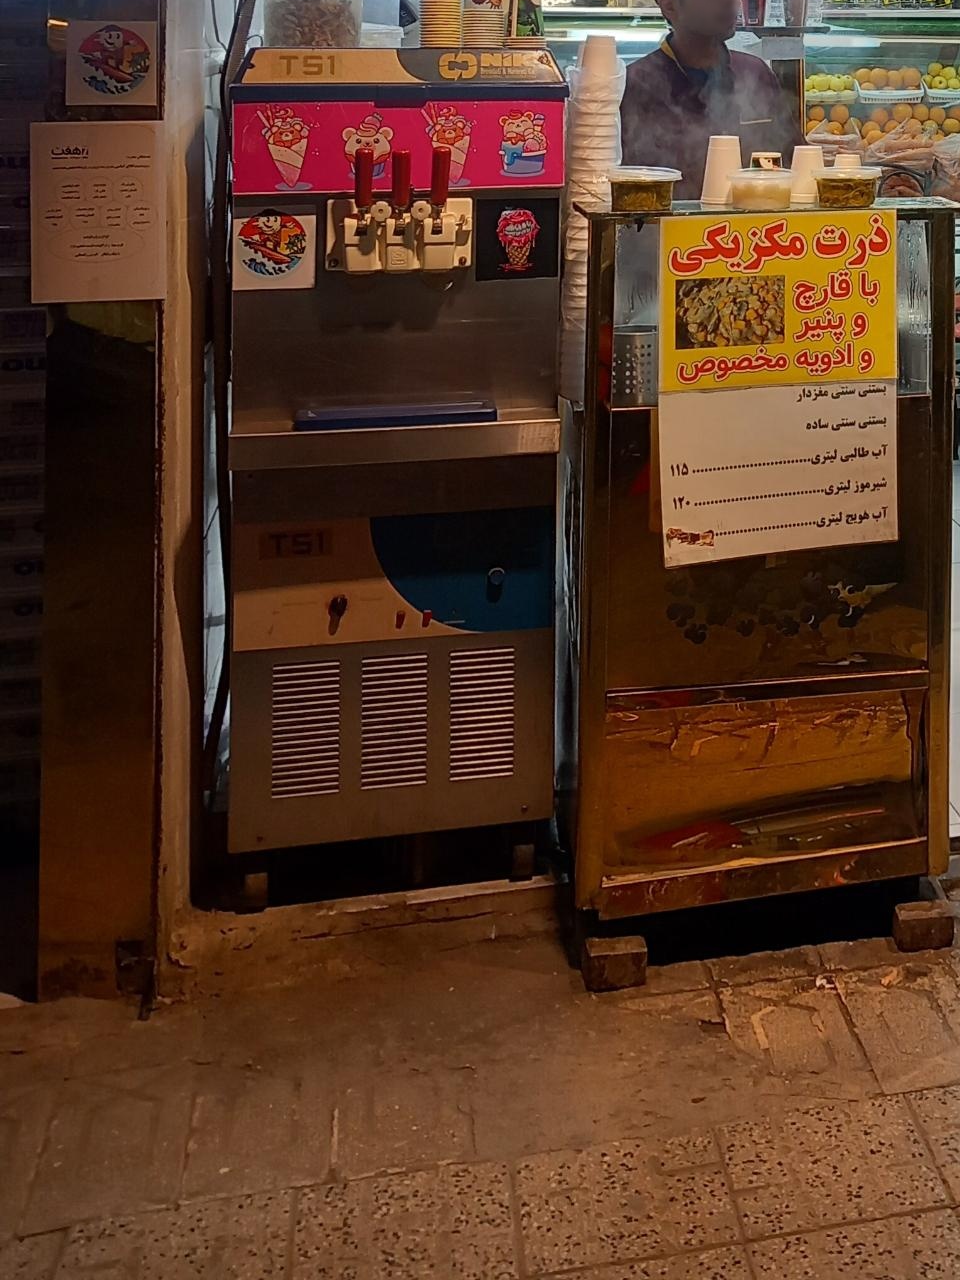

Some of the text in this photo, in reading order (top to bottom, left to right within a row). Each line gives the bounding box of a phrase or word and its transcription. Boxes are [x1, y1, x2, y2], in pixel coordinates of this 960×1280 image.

[278, 55, 336, 76] TS1
[668, 213, 891, 275] ذرت مکزیکی
[791, 268, 880, 312] با قارچ
[793, 308, 869, 342] و پنیر
[677, 342, 875, 384] و ادویه مخصوص
[796, 384, 887, 403] بستنی سنتی مغزدار
[805, 416, 887, 432] بستنی سنتی ساده
[840, 447, 870, 463] طالبی
[871, 444, 889, 459] آب
[670, 462, 689, 477] ۱۱۵
[672, 495, 691, 511] ۱۲۰
[845, 509, 870, 525] هویج
[871, 506, 889, 521] آب
